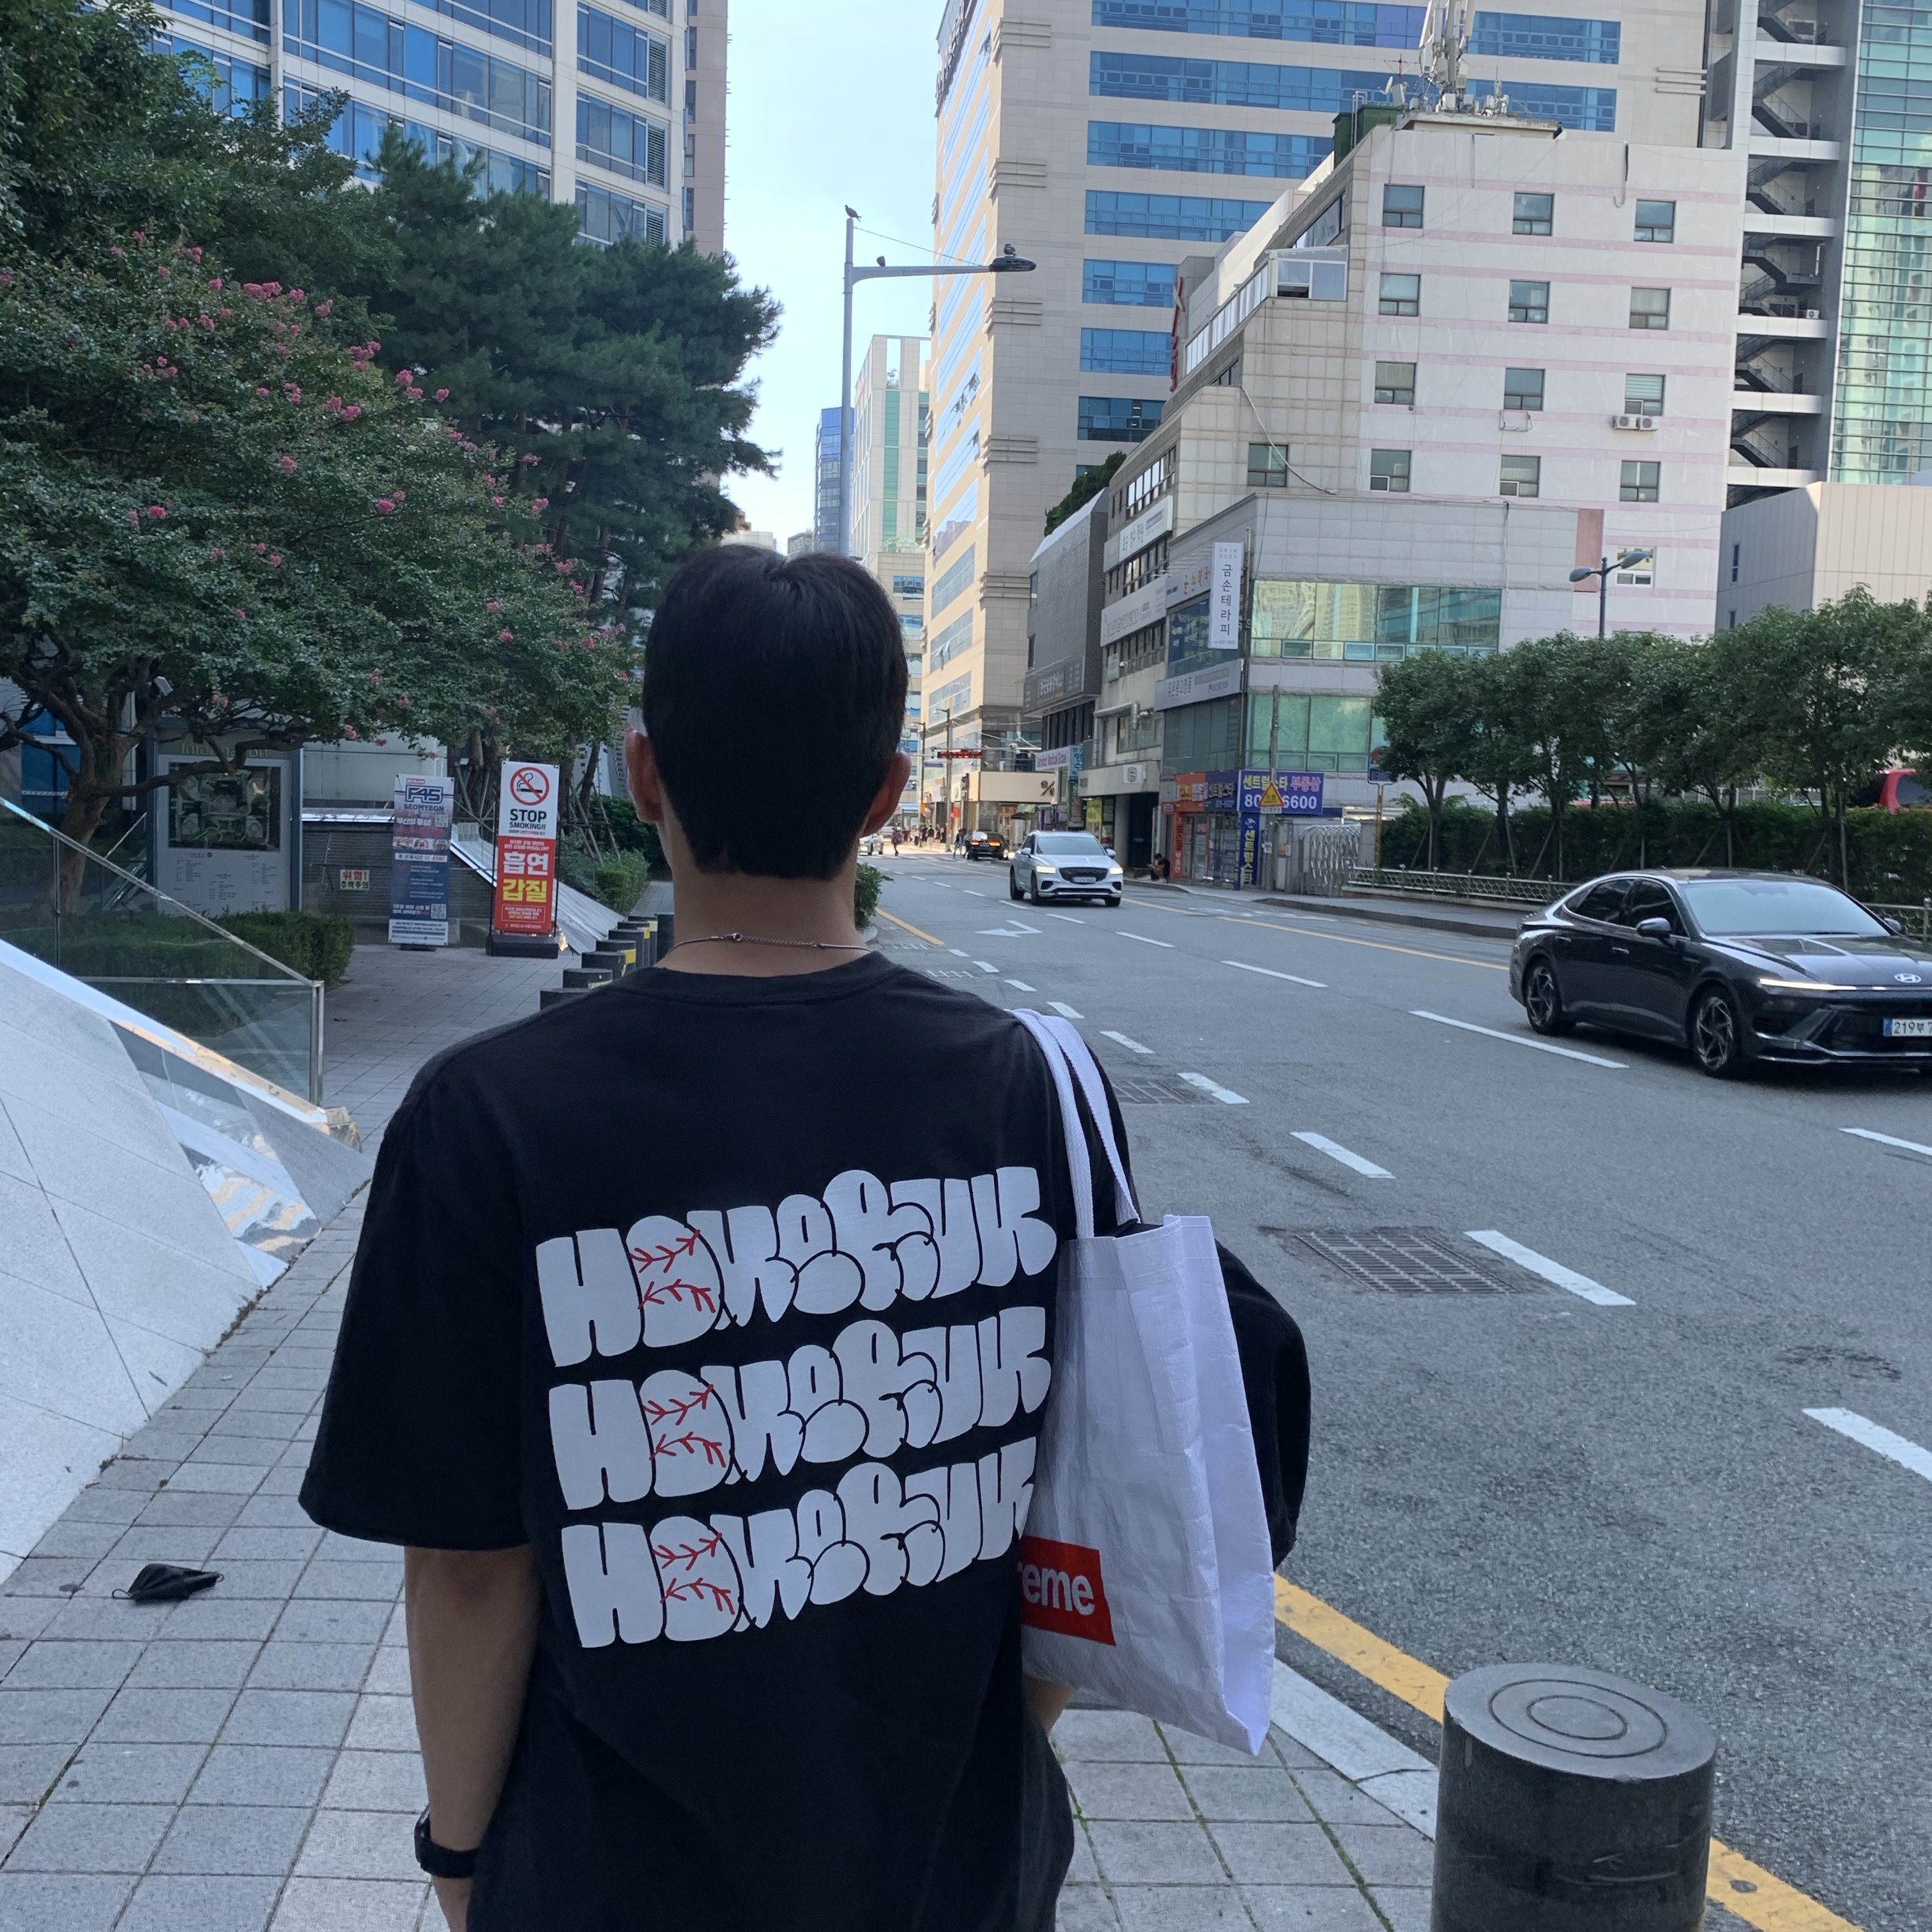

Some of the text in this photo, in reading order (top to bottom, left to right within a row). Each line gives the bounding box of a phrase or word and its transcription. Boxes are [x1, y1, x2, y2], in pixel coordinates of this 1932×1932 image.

[1220, 564, 1234, 636] 금손테라피
[1243, 775, 1321, 792] 센트럴타 부동산
[408, 786, 441, 802] F45
[1245, 793, 1317, 809] 806600
[404, 804, 444, 812] SEOMYEON
[510, 809, 547, 823] STOP
[509, 822, 546, 830] SMOKING!!
[503, 850, 549, 876] 흡연
[1243, 830, 1255, 885] 센트럴스타
[503, 878, 548, 903] 갑질
